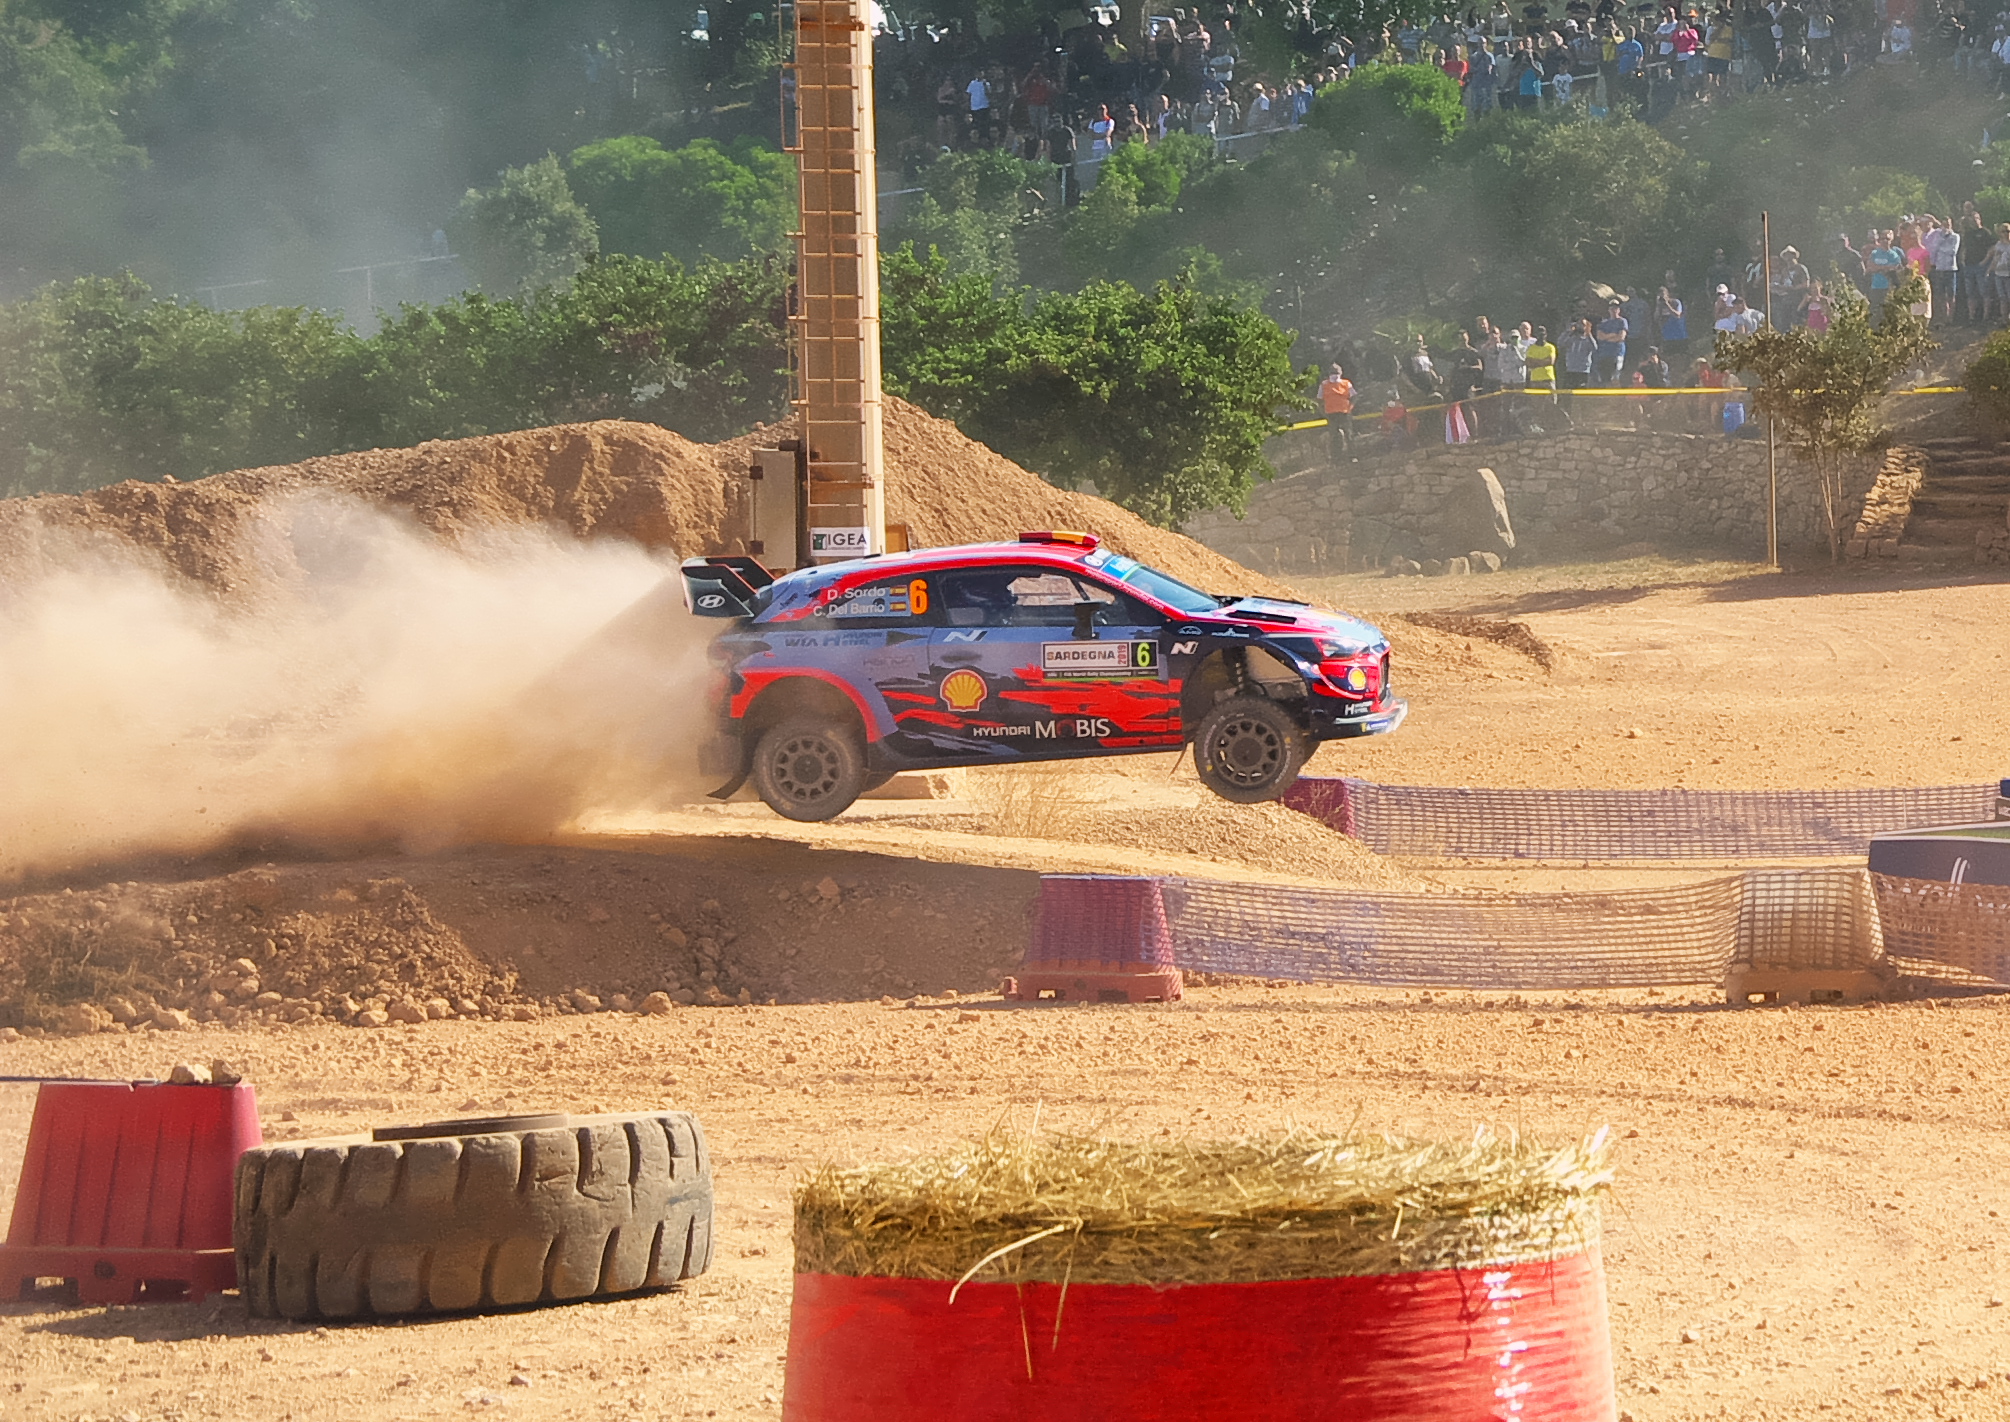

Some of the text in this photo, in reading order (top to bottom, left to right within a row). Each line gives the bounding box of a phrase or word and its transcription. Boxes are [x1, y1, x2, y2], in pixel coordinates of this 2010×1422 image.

[828, 533, 867, 546] IGEA
[827, 586, 886, 601] D. Sordo
[909, 578, 929, 616] 6
[813, 601, 886, 617] C. Del Barrio
[1046, 650, 1116, 661] SARDEGNA
[1117, 644, 1127, 665] 2019
[1137, 642, 1150, 667] 6
[973, 718, 1111, 739] HYUNDAI MOBIS
